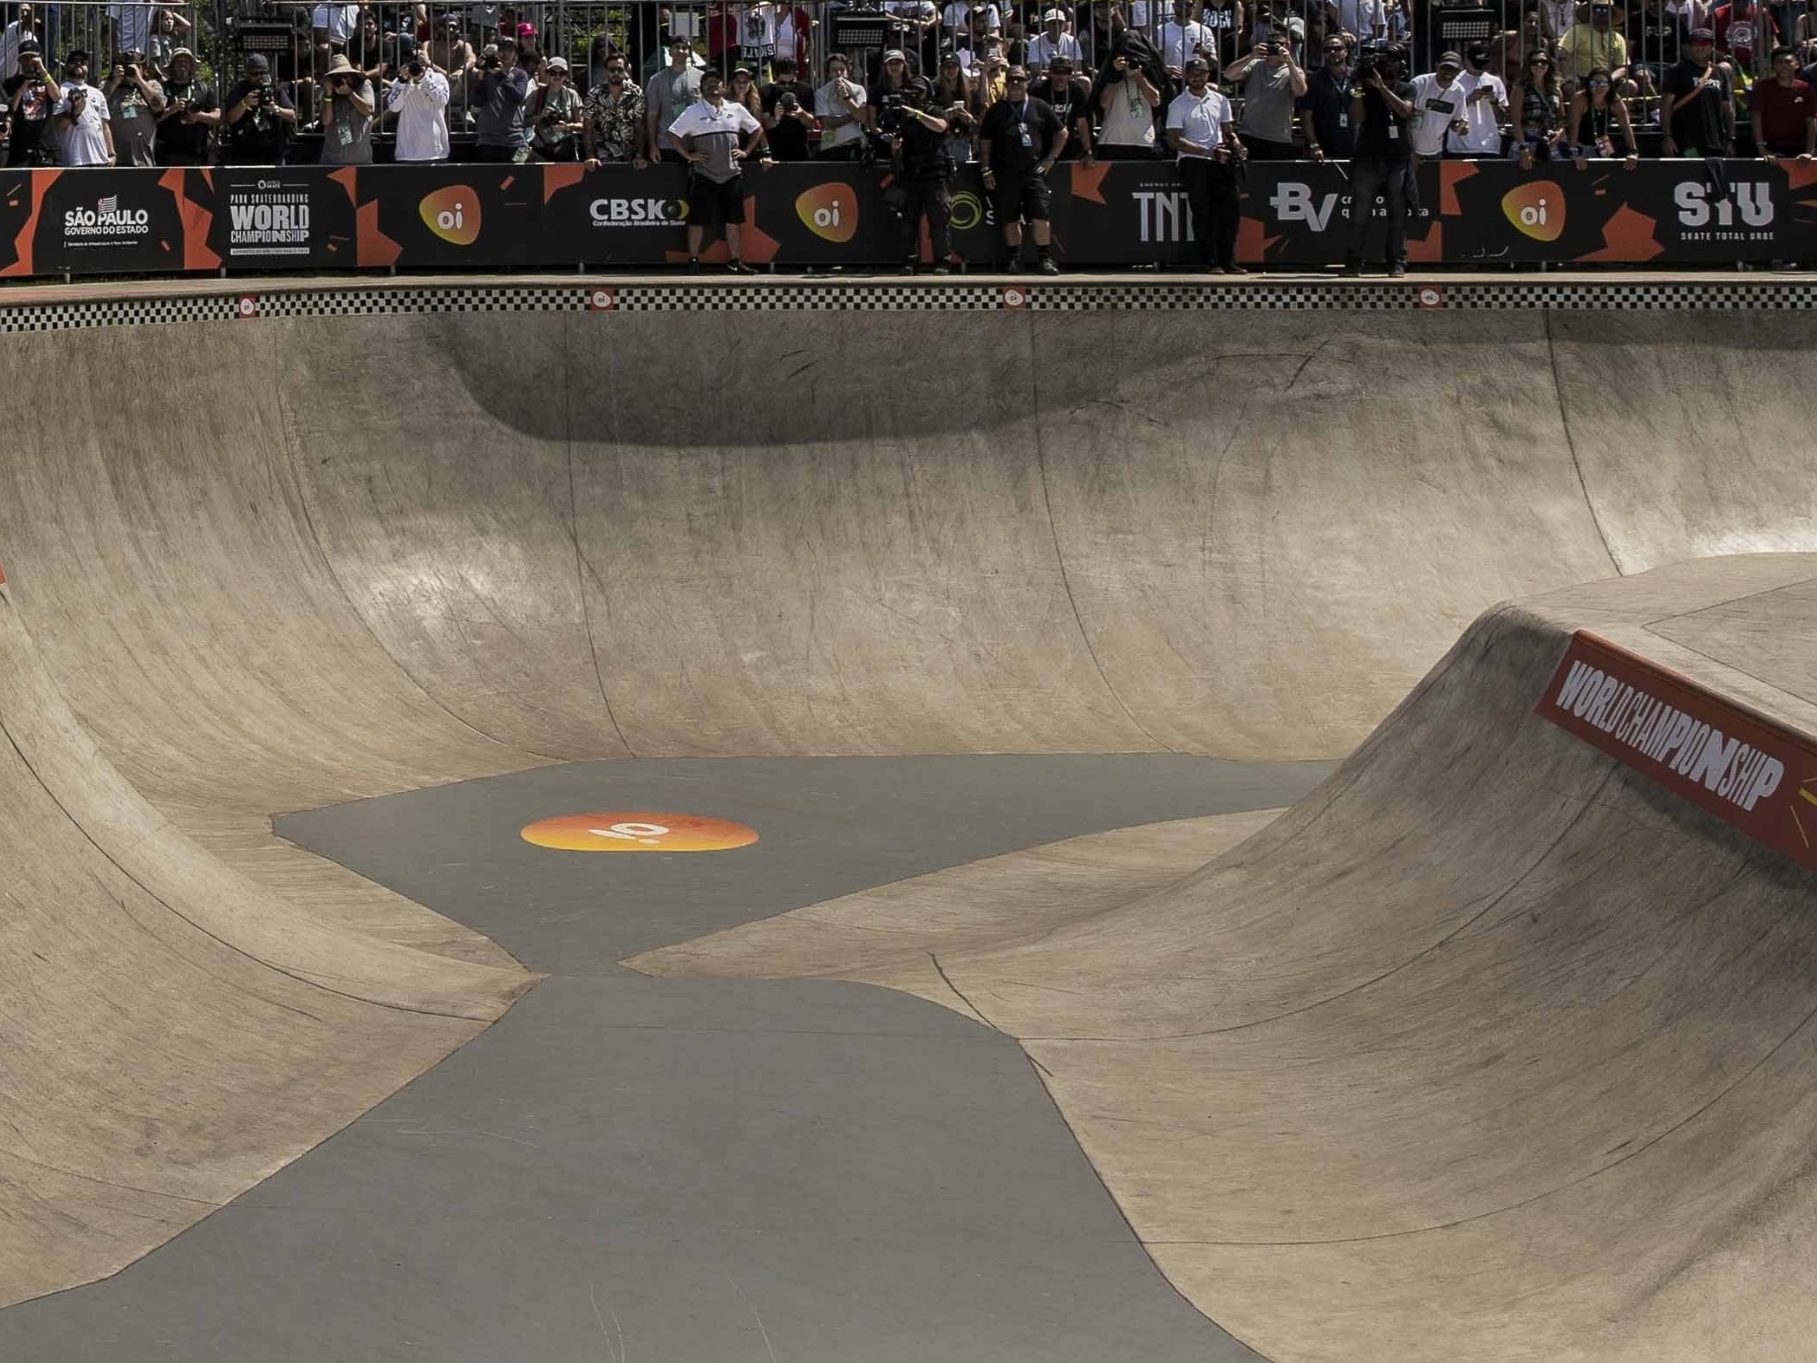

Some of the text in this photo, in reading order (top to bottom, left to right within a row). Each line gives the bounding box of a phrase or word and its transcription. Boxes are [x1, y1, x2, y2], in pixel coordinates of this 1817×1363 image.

[65, 207, 148, 226] SÃO PAULO
[230, 204, 310, 230] WORLD
[437, 202, 463, 230] oi
[589, 198, 666, 220] CBSK
[813, 200, 840, 227] oi
[1270, 182, 1338, 232] BV
[1520, 198, 1546, 226] oi
[65, 225, 148, 236] GOVERNO DO ESTADO
[230, 230, 309, 243] CHAMPIONSHIP
[1681, 232, 1711, 240] SKATE
[1715, 232, 1745, 240] TOTAL
[1555, 660, 1784, 812] WORLD CHAMPIONSHIP
